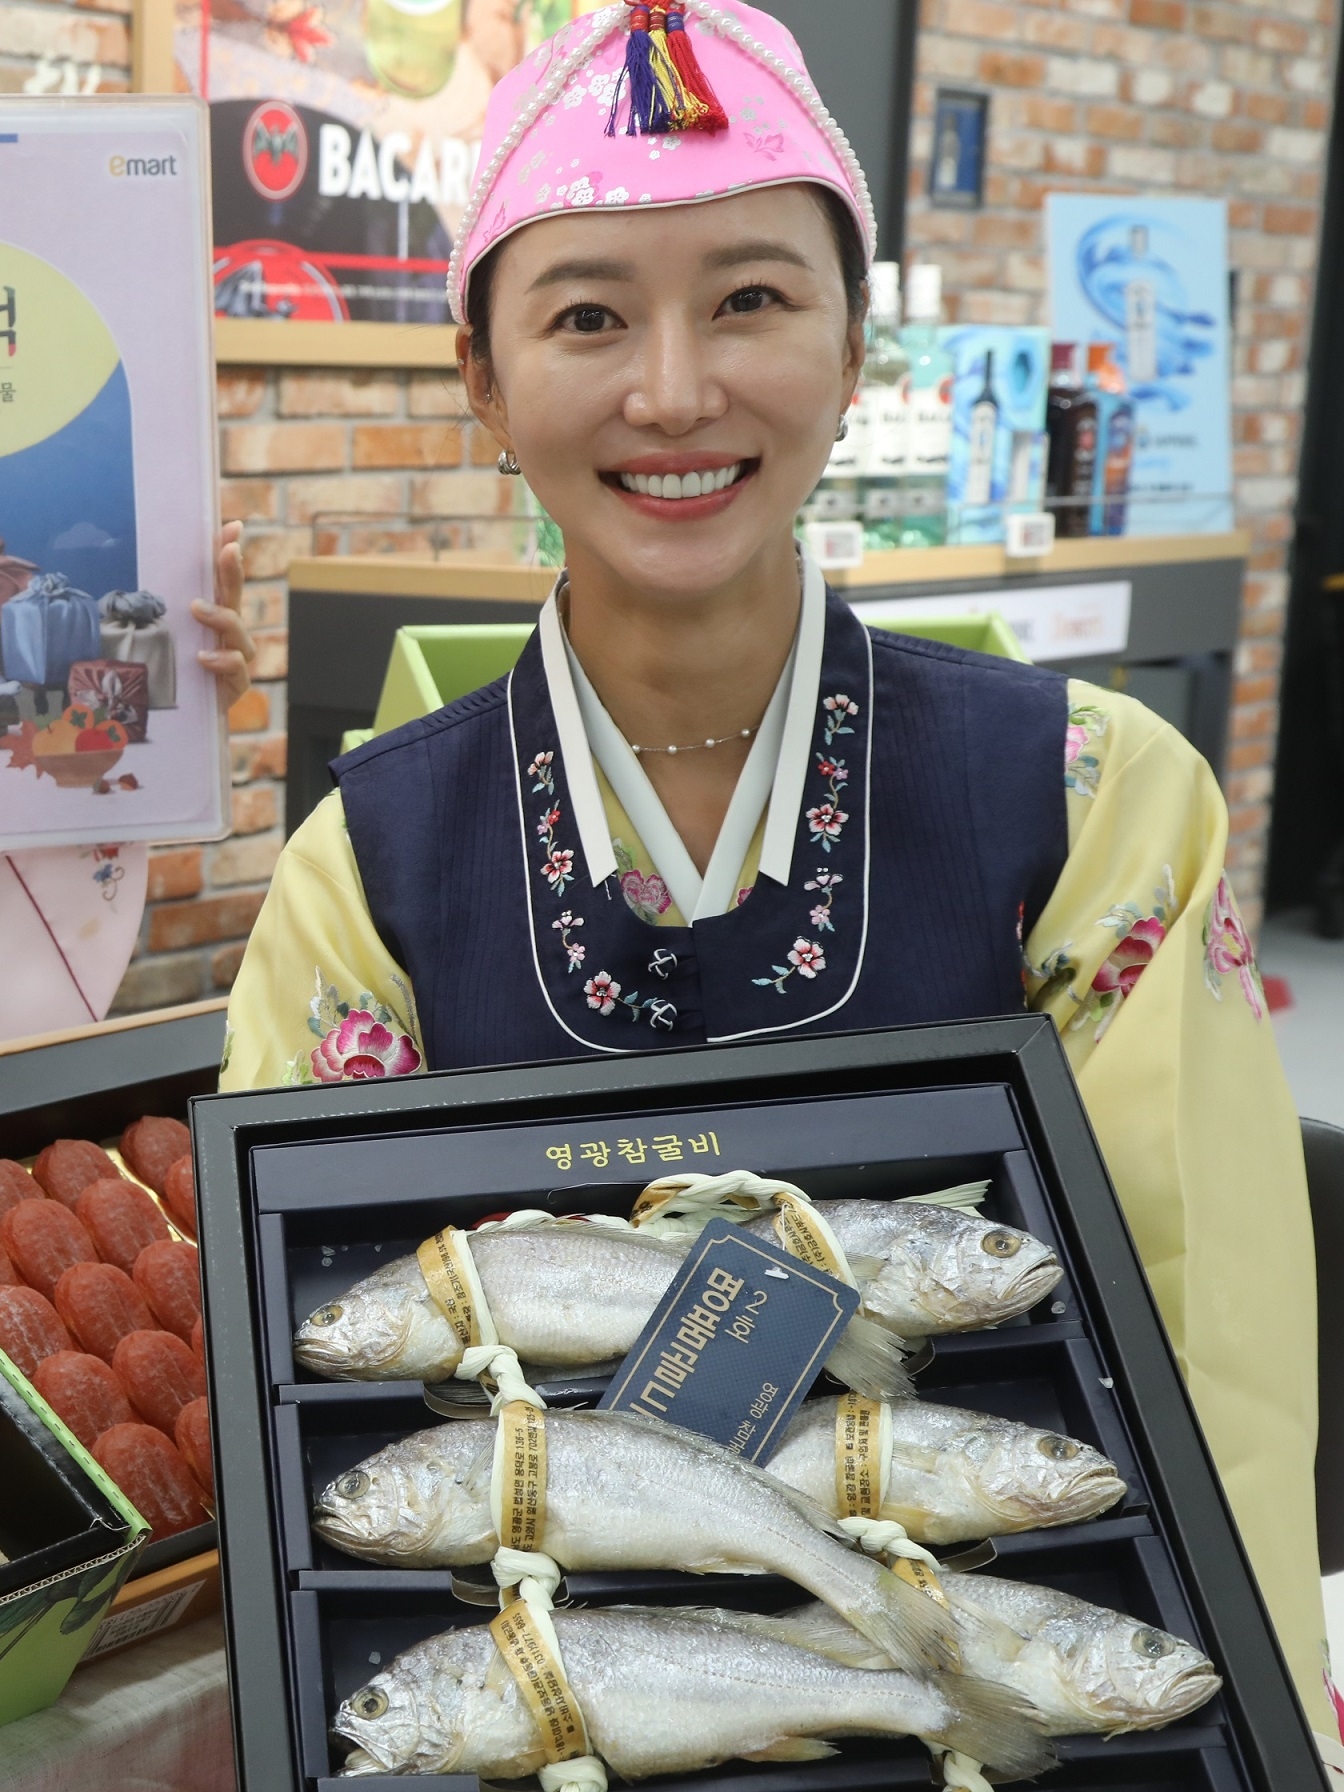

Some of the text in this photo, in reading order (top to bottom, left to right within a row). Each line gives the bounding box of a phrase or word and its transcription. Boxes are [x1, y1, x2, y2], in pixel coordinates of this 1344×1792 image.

[108, 154, 178, 177] emart
[545, 1131, 721, 1171] 영광참굴비
[630, 1267, 744, 1417] 명품골드
[750, 1382, 779, 1419] 영광
